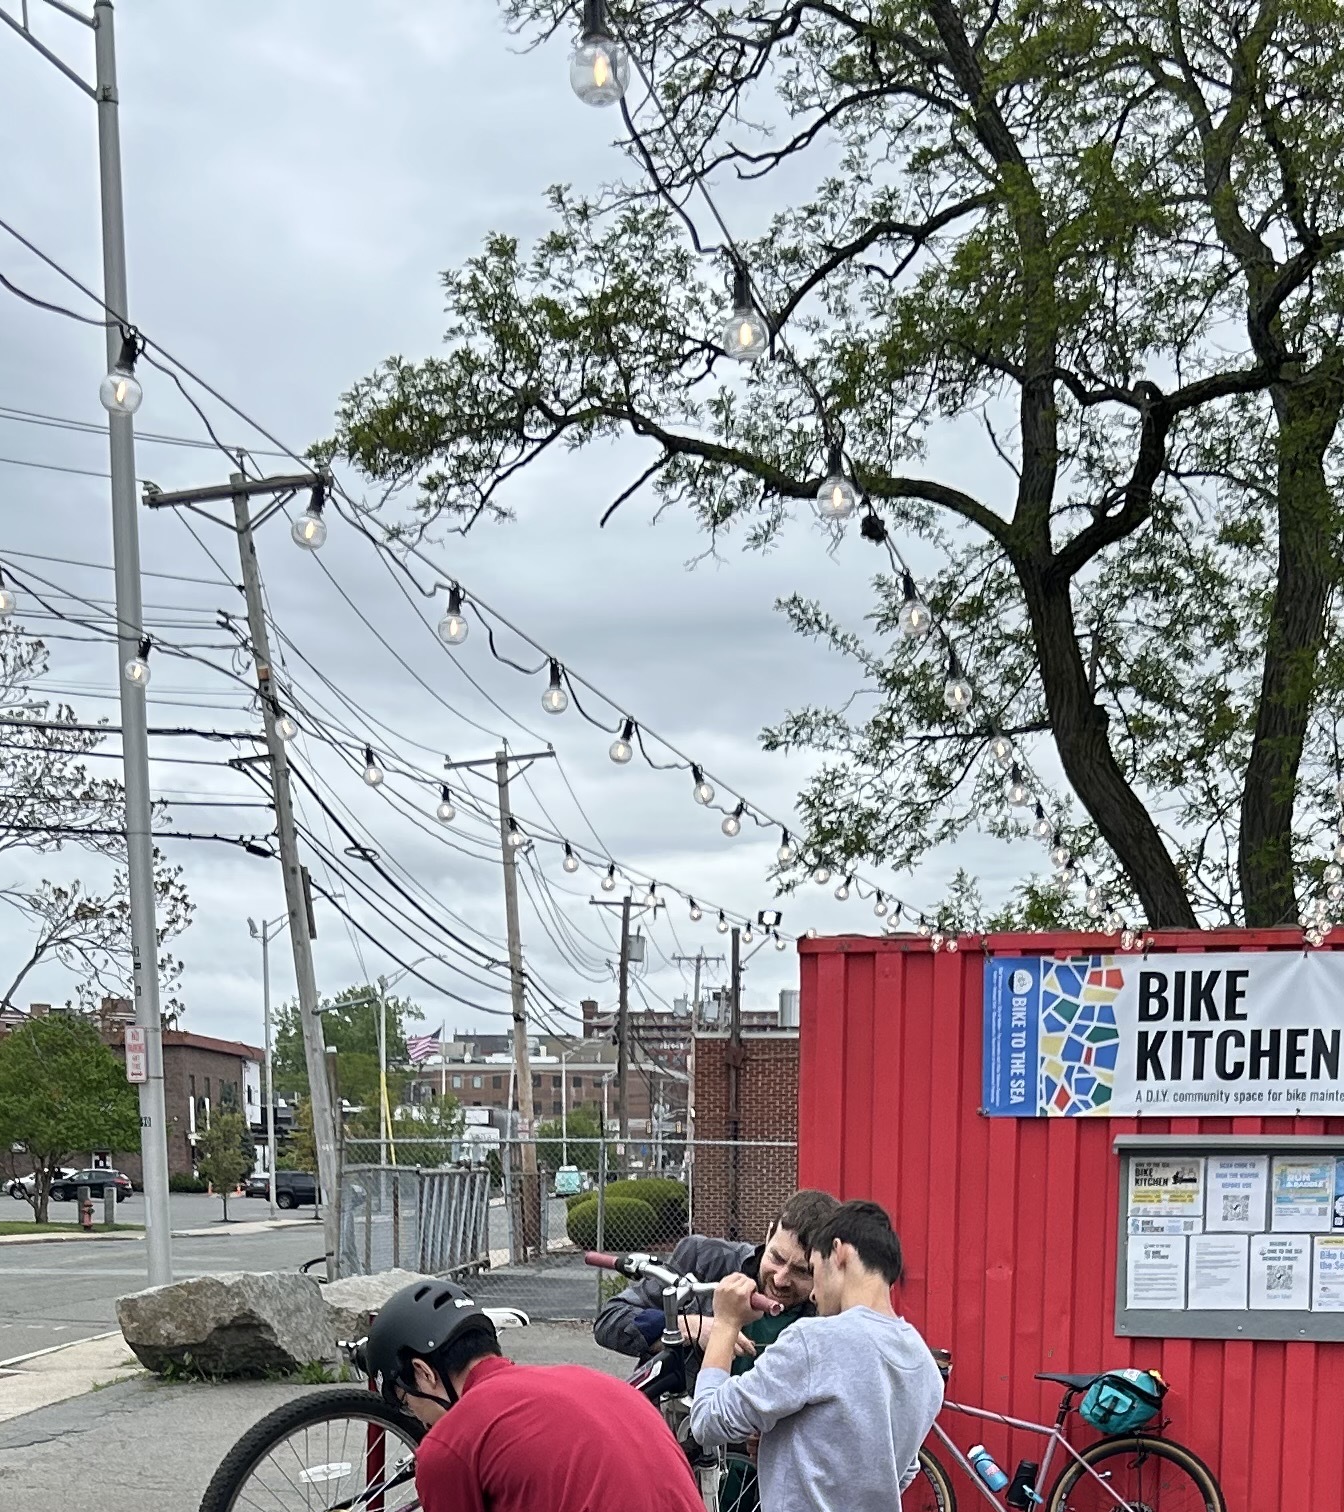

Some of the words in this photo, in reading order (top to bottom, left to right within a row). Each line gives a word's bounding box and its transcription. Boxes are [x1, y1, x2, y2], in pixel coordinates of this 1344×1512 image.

[1138, 970, 1249, 1022] BIKE
[1011, 997, 1027, 1028] BIKE
[1010, 1032, 1026, 1048] TO
[1010, 1051, 1025, 1076] THE
[1135, 1029, 1341, 1081] KITCHEN
[1009, 1079, 1025, 1104] SEA
[1135, 1090, 1143, 1102] A
[1173, 1090, 1230, 1104] community
[1234, 1091, 1263, 1104] space
[1268, 1089, 1282, 1102] for
[1286, 1089, 1306, 1102] bike
[1134, 1177, 1169, 1187] KITCHEN
